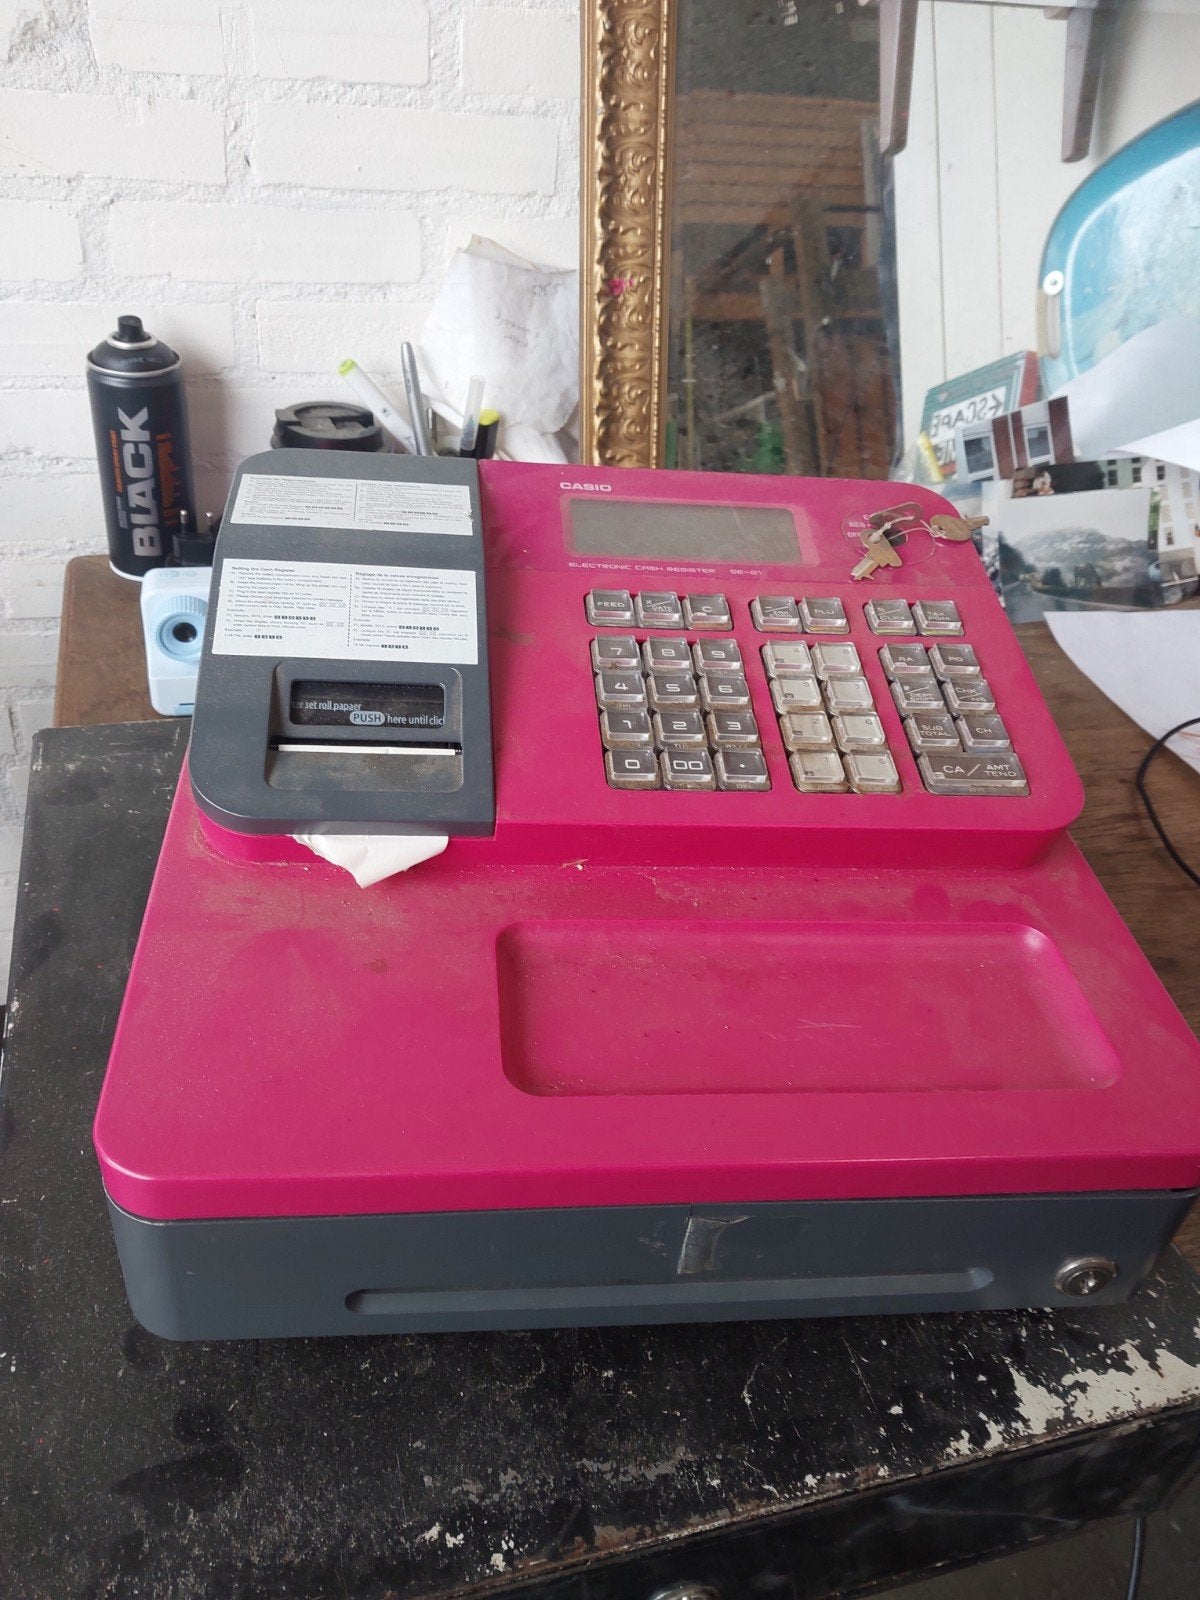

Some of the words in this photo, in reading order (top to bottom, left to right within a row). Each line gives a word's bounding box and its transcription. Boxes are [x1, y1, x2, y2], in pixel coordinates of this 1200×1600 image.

[117, 406, 162, 557] BLACK
[560, 482, 612, 492] CASIO
[568, 562, 632, 571] ELECTRONIC
[701, 605, 713, 613] C
[610, 647, 623, 656] 7
[661, 648, 676, 657] 8
[711, 650, 726, 659] 9
[614, 682, 629, 691] 4
[665, 683, 681, 693] 5
[718, 684, 734, 694] 6
[304, 701, 318, 710] set
[318, 700, 333, 711] roll
[333, 701, 362, 712] papaer
[353, 713, 381, 723] PUSH
[387, 713, 407, 724] here
[408, 713, 429, 726] until
[672, 721, 687, 730] 2
[725, 721, 742, 731] 3
[625, 759, 640, 769] 0
[673, 760, 704, 770] 00
[943, 765, 965, 773] CA
